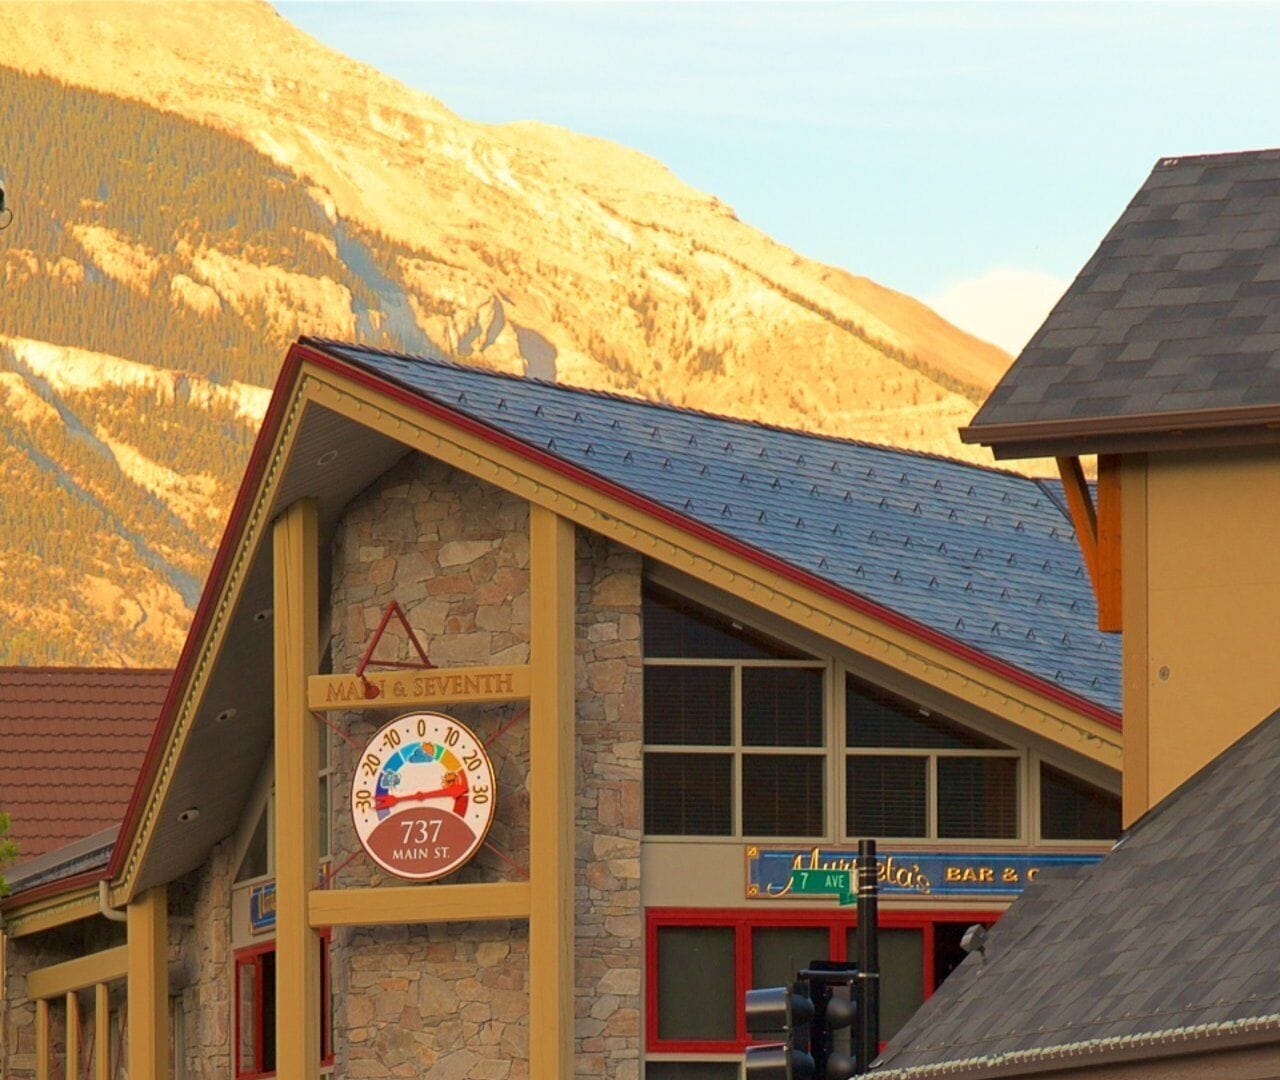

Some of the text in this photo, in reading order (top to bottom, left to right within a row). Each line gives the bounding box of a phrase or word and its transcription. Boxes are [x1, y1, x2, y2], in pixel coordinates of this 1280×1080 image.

[393, 681, 408, 698] &
[413, 673, 514, 698] SEVENTH
[417, 719, 426, 738] 0
[444, 726, 460, 747] 10
[463, 749, 482, 772] 20
[472, 785, 488, 804] 30
[400, 820, 443, 845] 737
[393, 847, 451, 861] MAIN ST.
[767, 847, 931, 898] Meta's
[946, 867, 994, 882] BAR
[1002, 867, 1018, 882] &
[800, 873, 845, 889] 7 AVE
